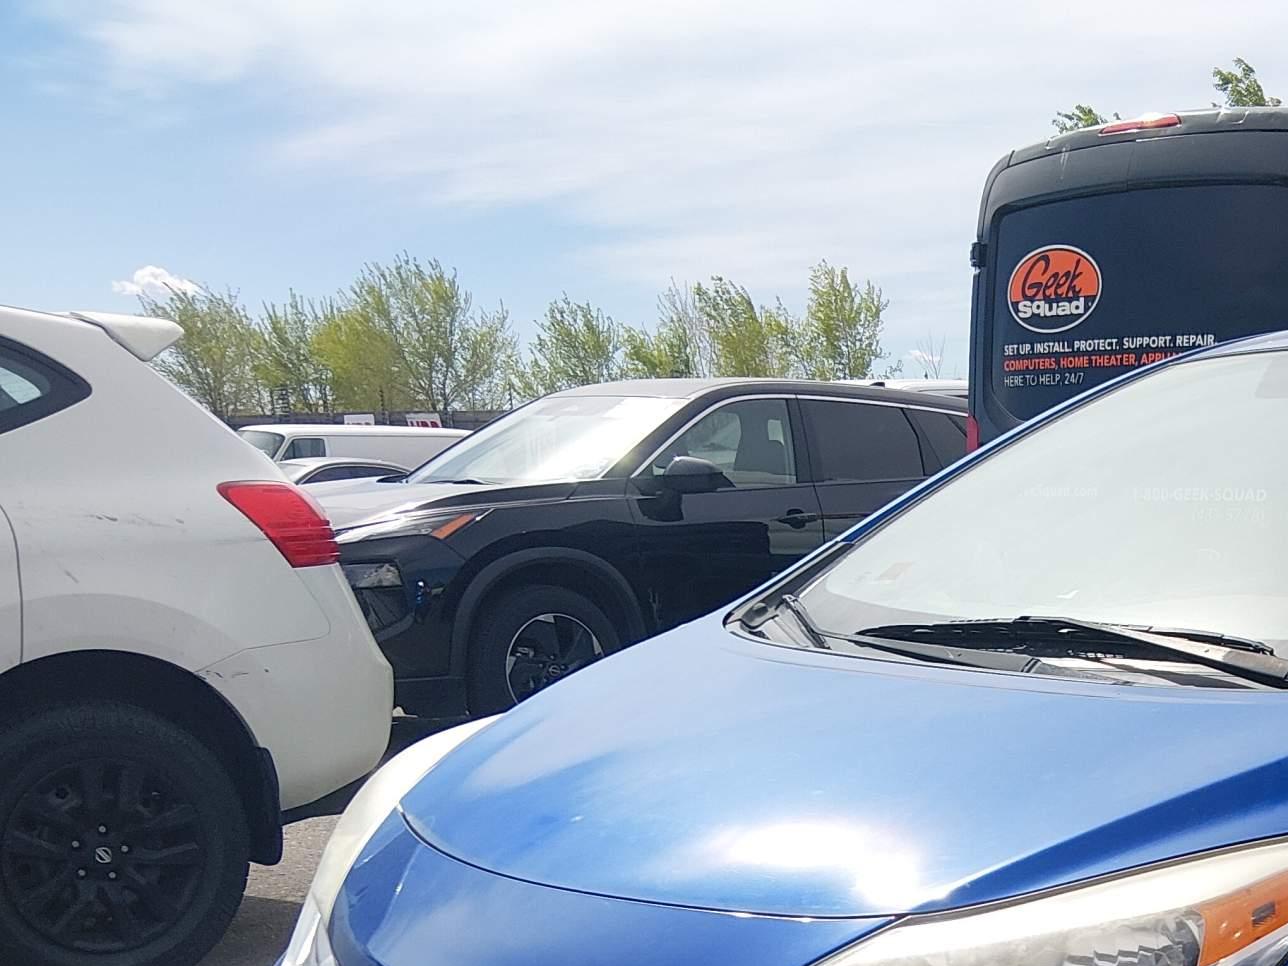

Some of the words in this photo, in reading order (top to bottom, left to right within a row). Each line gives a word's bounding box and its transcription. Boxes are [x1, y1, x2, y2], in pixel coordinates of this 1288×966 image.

[1021, 254, 1083, 300] Geek
[1034, 341, 1072, 354] INSTALL.
[1074, 338, 1119, 352] PROTECT.
[1123, 335, 1173, 349] SUPPORT.
[1003, 358, 1058, 372] COMPUTERS,
[1060, 356, 1089, 369] HOME
[1091, 353, 1138, 367] THEATER,
[1003, 375, 1024, 387] HERE
[1025, 374, 1037, 386] TO
[1039, 373, 1063, 386] HELP,
[1064, 371, 1084, 385] 24/7
